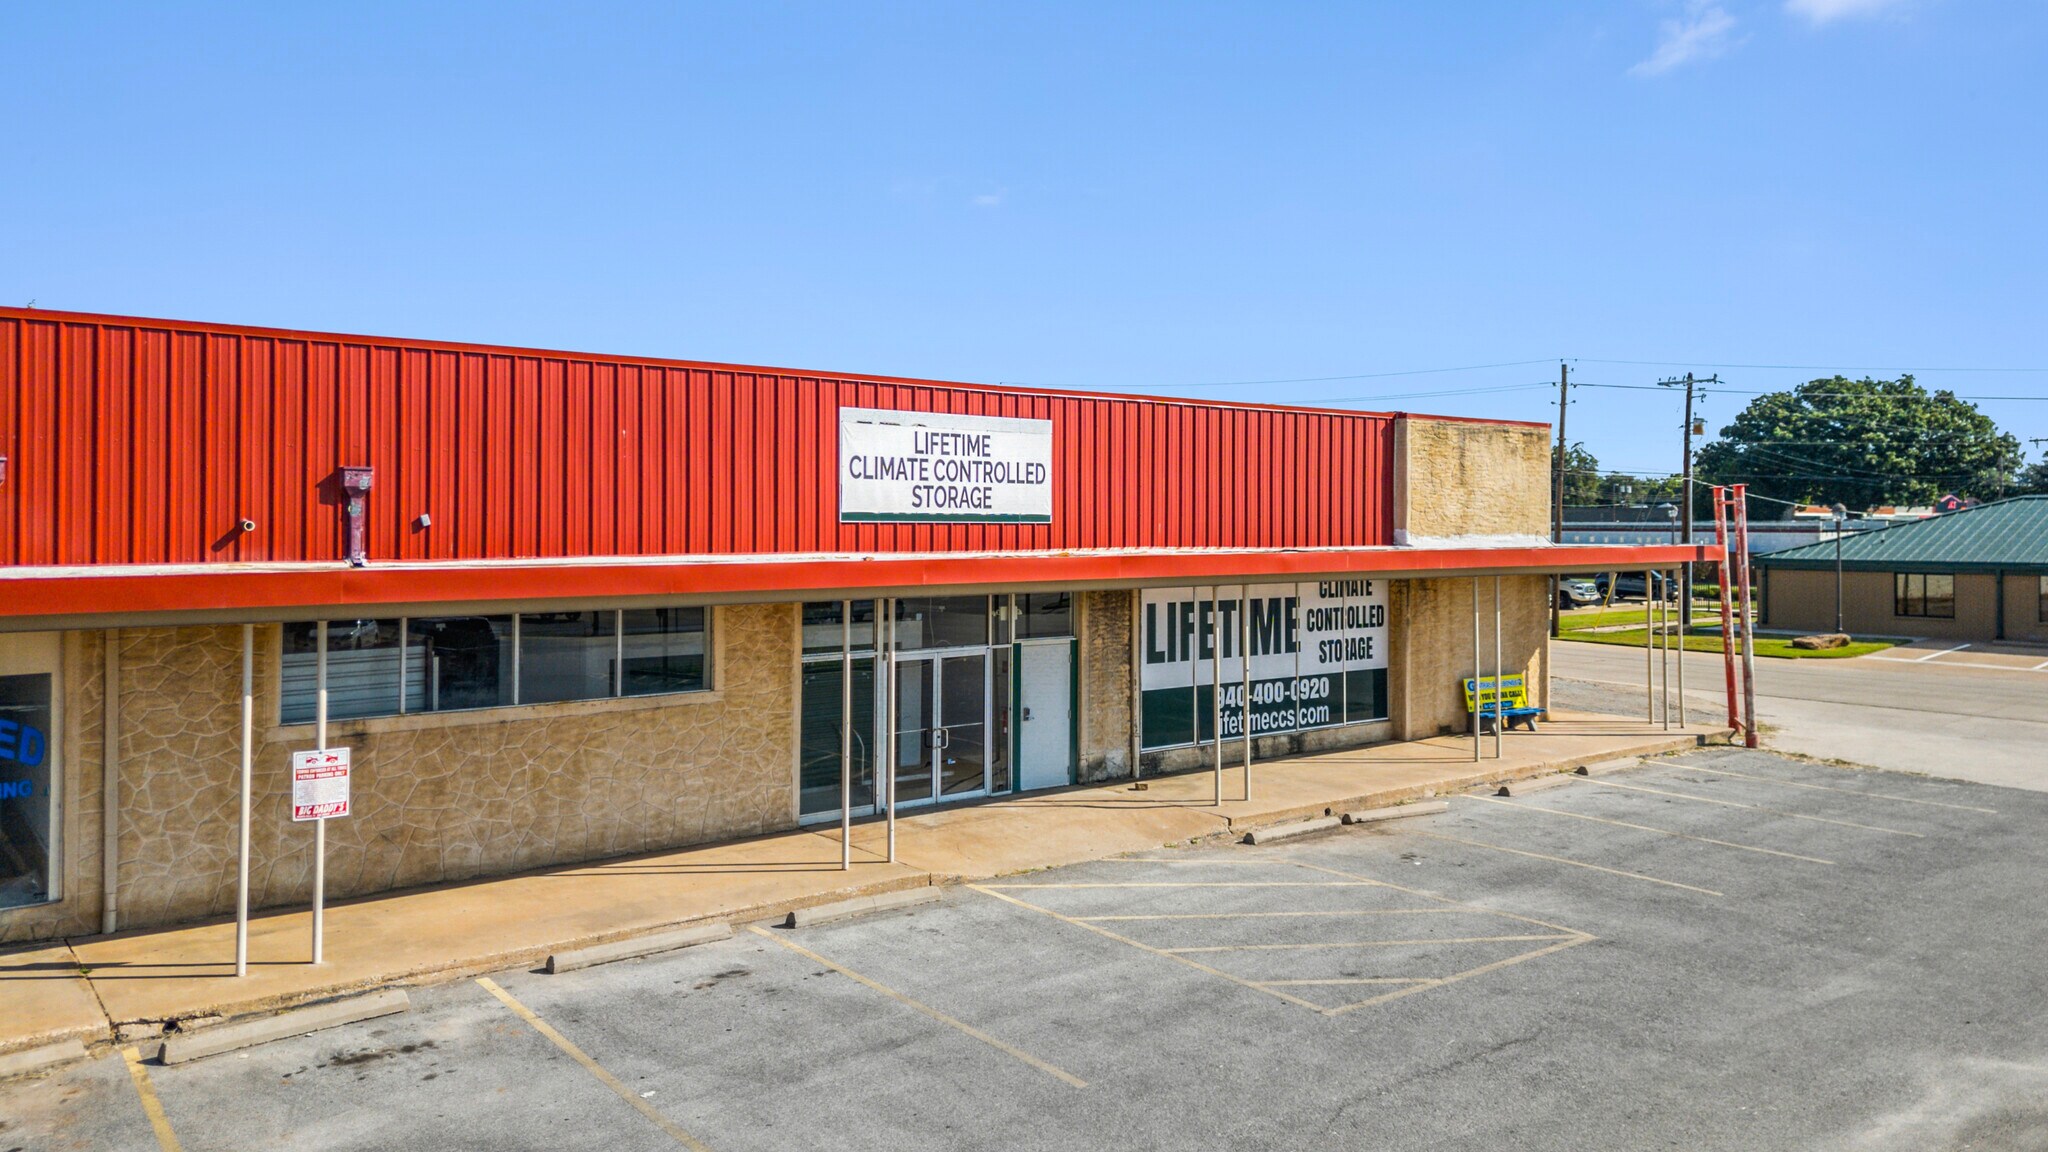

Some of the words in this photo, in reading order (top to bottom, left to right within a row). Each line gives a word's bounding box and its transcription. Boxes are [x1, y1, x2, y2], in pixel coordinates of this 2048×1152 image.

[914, 431, 991, 457] LIFETIME
[849, 455, 929, 481] CLIMATE
[934, 459, 1046, 485] CONTROLLED
[912, 485, 992, 509] STORAGE
[1146, 596, 1301, 664] LIFETIME
[1219, 705, 1330, 735] ifetmeccscom
[298, 806, 312, 816] BIG
[313, 802, 345, 814] DADDY'S
